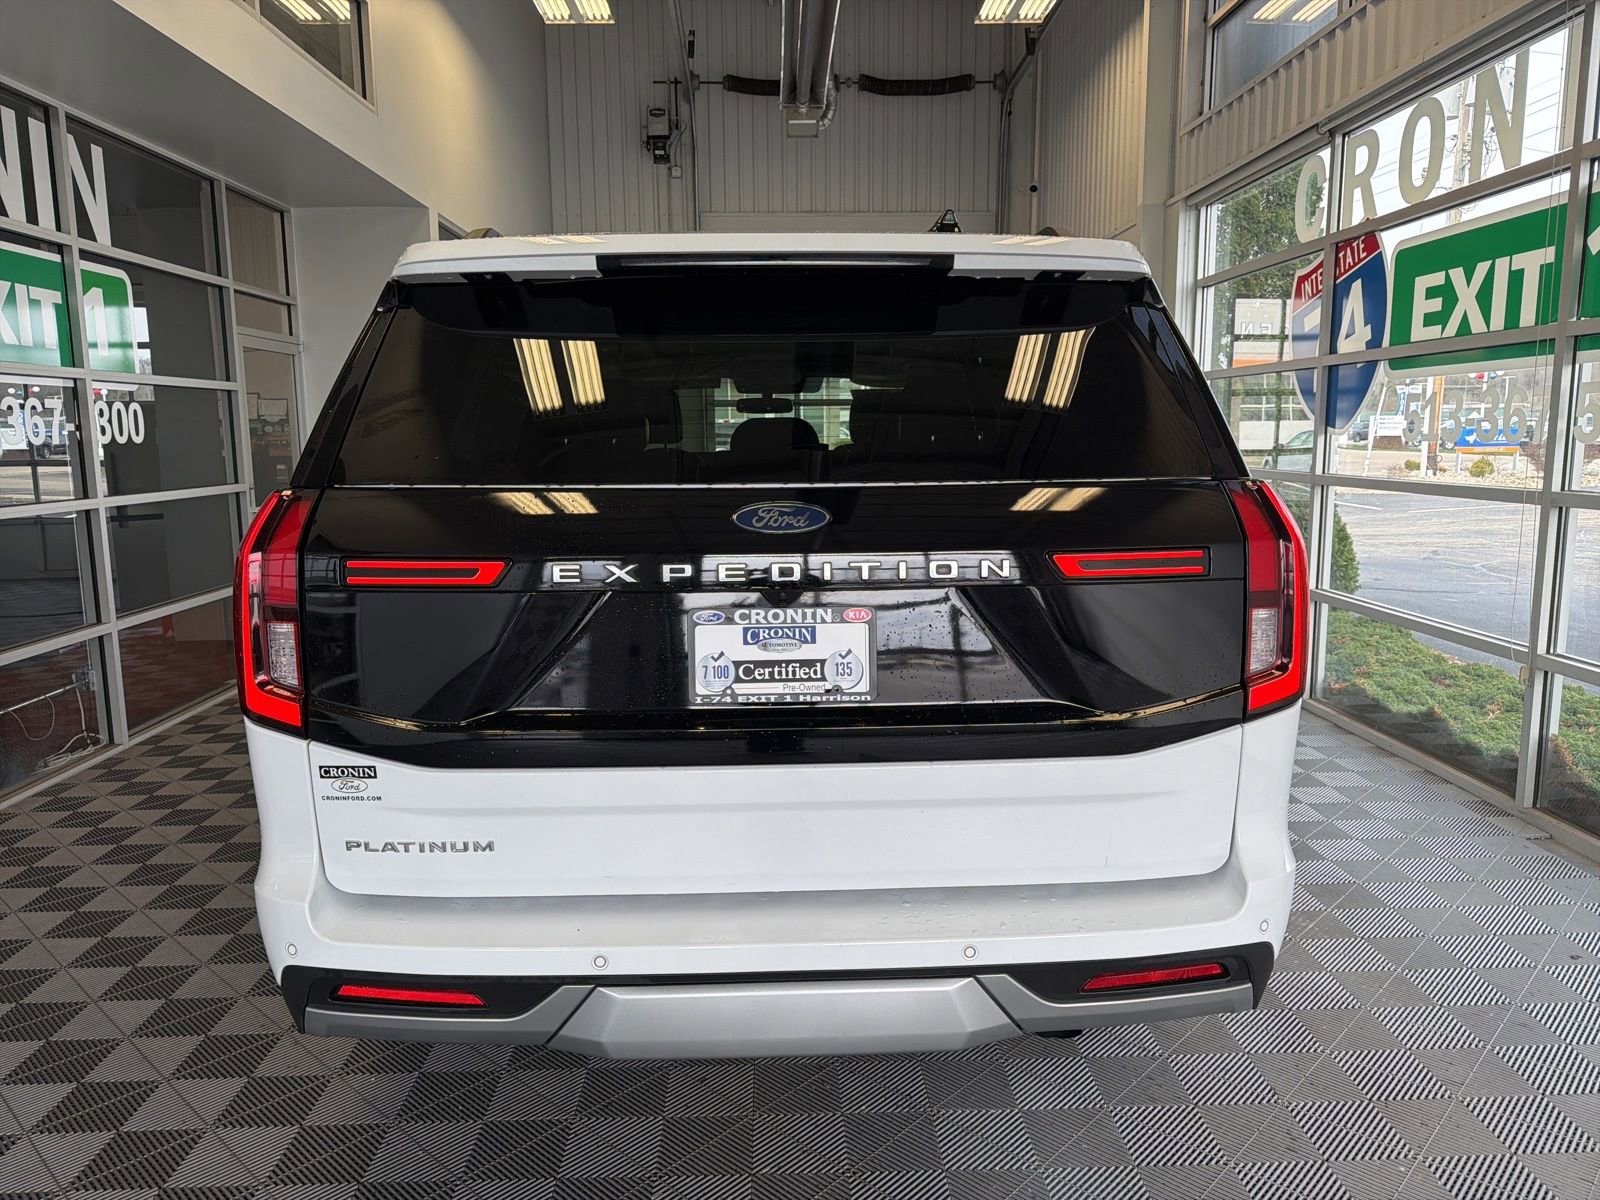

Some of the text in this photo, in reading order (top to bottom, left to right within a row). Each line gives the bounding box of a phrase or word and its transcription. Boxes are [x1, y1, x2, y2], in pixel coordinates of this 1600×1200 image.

[1300, 235, 1368, 302] INTETATE
[1409, 245, 1556, 343] EXIT
[750, 504, 811, 530] Ford
[552, 559, 1011, 583] EXPEDITION
[733, 608, 833, 625] CRONIN
[746, 627, 812, 644] CRONIN
[702, 664, 730, 680] 7 100
[738, 662, 822, 680] Certified
[834, 661, 853, 677] 135
[782, 683, 826, 693] Pre-Owned
[694, 693, 872, 704] I-74 EXIT 1 Harrison
[320, 766, 376, 777] CRONIN
[338, 780, 361, 792] Ford
[344, 840, 495, 853] PLATINUM
